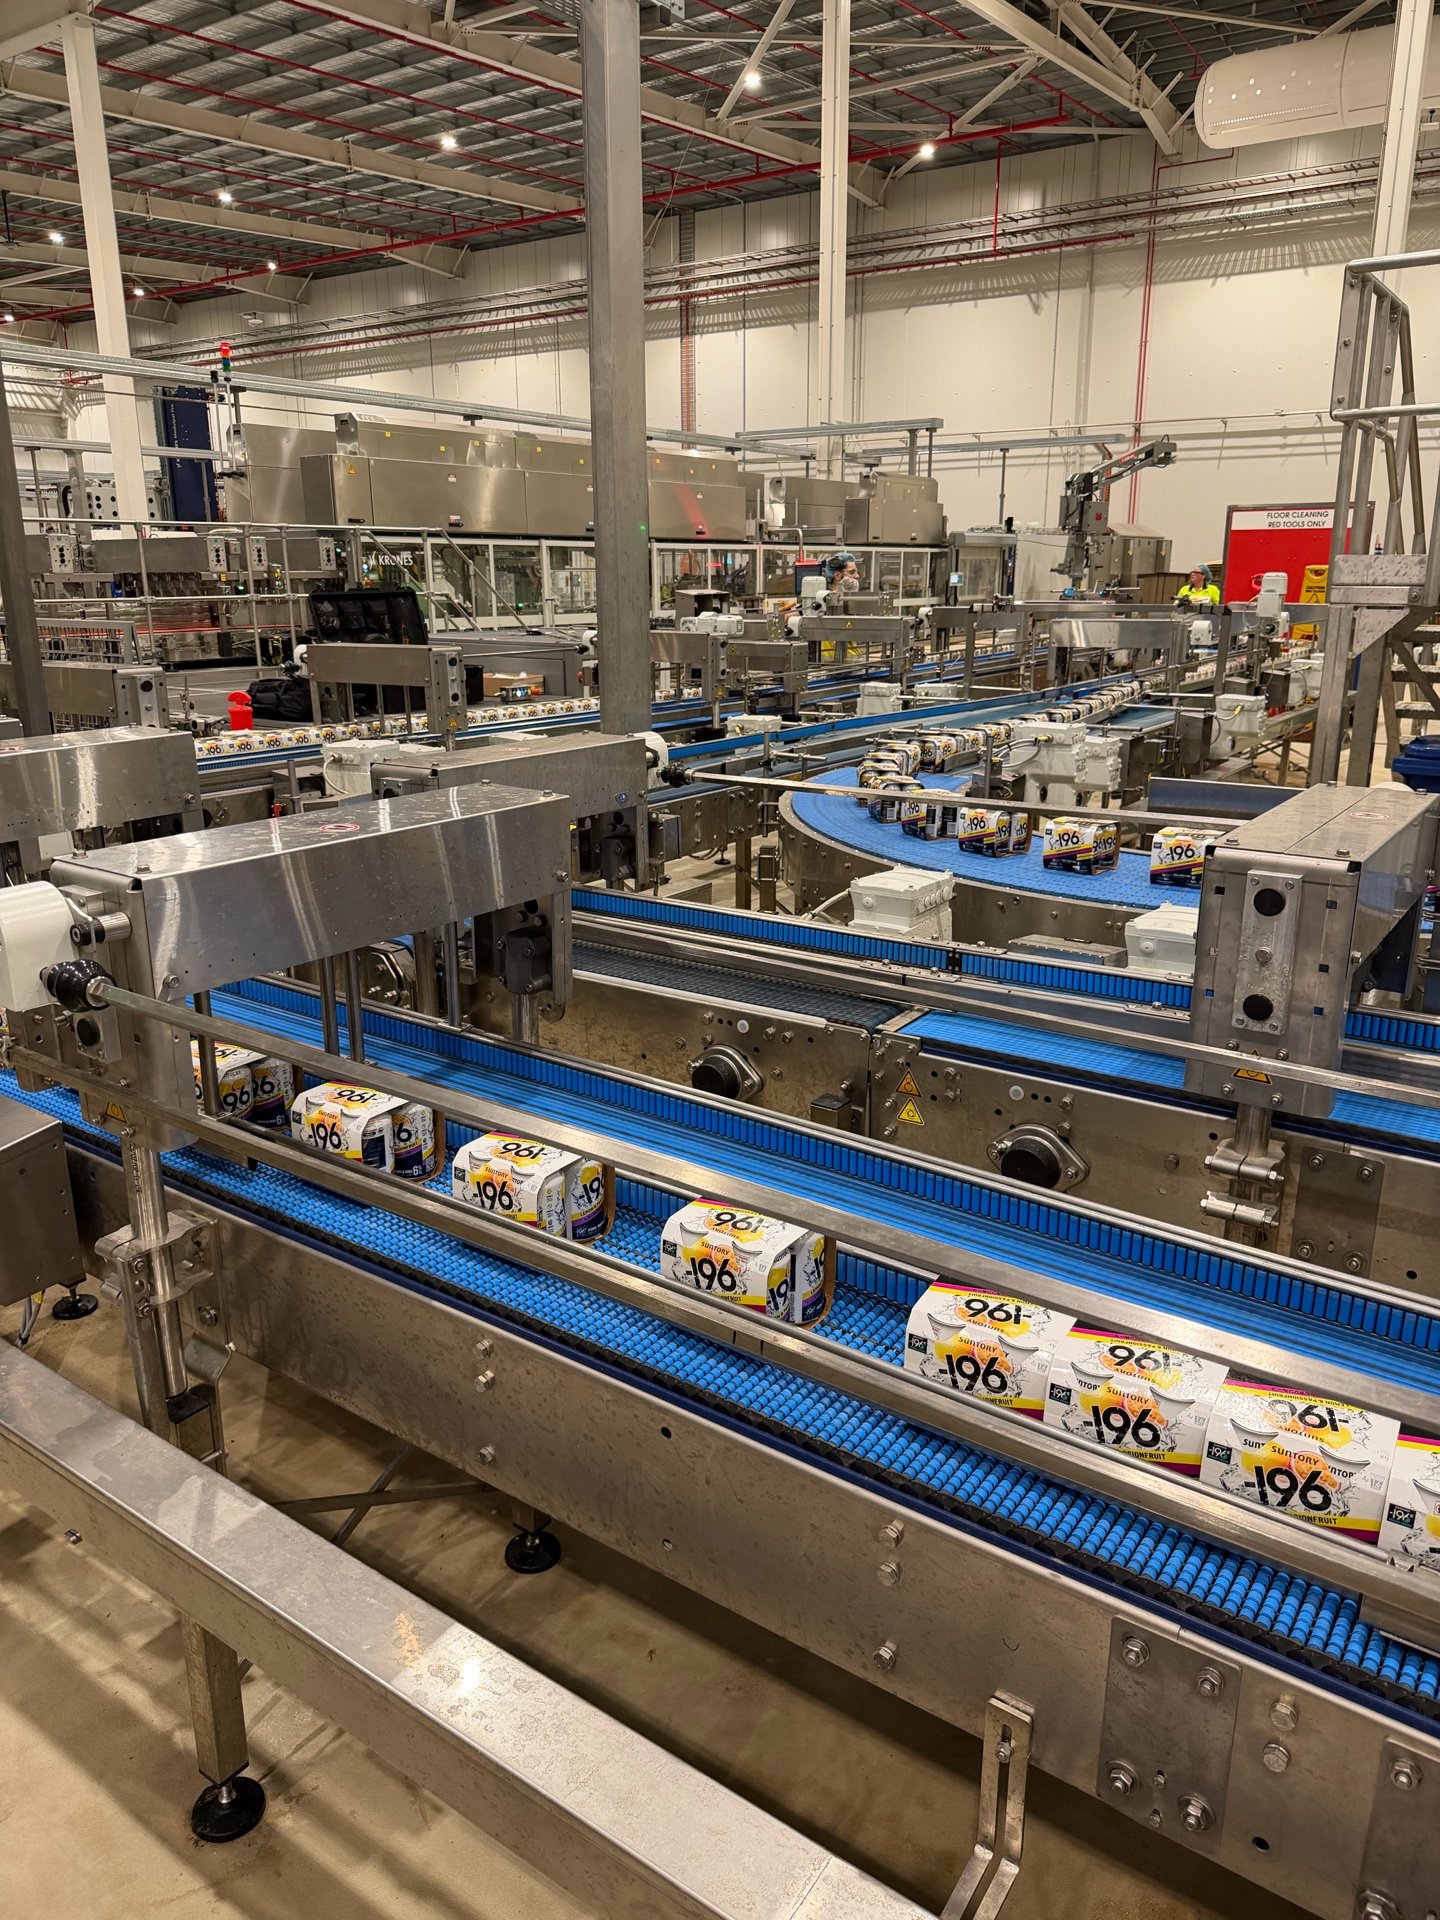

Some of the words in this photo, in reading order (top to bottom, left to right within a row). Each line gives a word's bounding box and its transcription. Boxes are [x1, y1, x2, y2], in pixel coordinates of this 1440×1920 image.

[378, 555, 413, 565] KRONES
[968, 816, 986, 831] -196
[1056, 831, 1080, 847] -196
[1166, 844, 1195, 861] -196
[337, 1089, 378, 1104] -196
[308, 1122, 342, 1150] -196
[502, 1142, 547, 1159] -196
[473, 1181, 513, 1210] -196
[701, 1241, 731, 1256] SUNTORY
[686, 1257, 736, 1291] -196
[965, 1299, 1032, 1324] -196
[958, 1336, 997, 1353] SUNTORY
[1108, 1345, 1182, 1373] -196
[939, 1354, 1008, 1394] -196
[1107, 1386, 1149, 1404] SUNTORY
[1268, 1399, 1349, 1432] -196
[1083, 1405, 1160, 1448] -196
[1272, 1445, 1319, 1466] SUNTORY
[1244, 1466, 1332, 1511] -196
